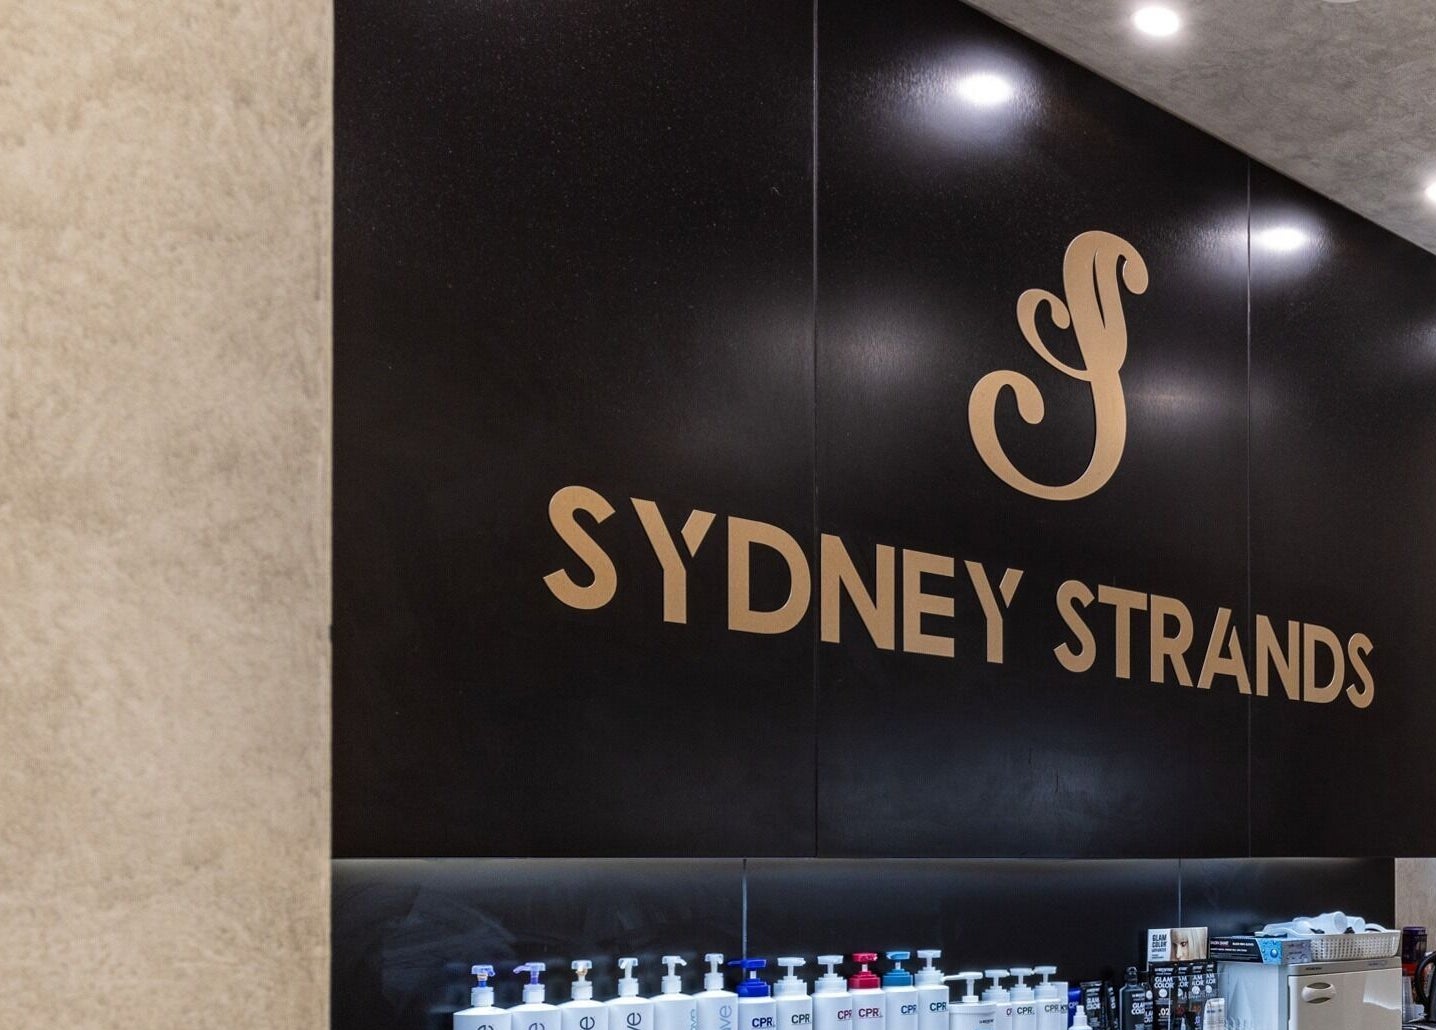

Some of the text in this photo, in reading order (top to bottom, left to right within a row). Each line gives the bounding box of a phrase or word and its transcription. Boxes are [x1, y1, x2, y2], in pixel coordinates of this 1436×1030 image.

[543, 485, 1375, 709] SYDNEY STRANDS
[929, 1002, 947, 1012] CPR
[1017, 1007, 1033, 1015] CPR
[1045, 1004, 1059, 1012] CPR
[1158, 1007, 1171, 1016] .02
[858, 1008, 879, 1017] CPR
[751, 1017, 773, 1028] CPR
[791, 1014, 810, 1024] CPR
